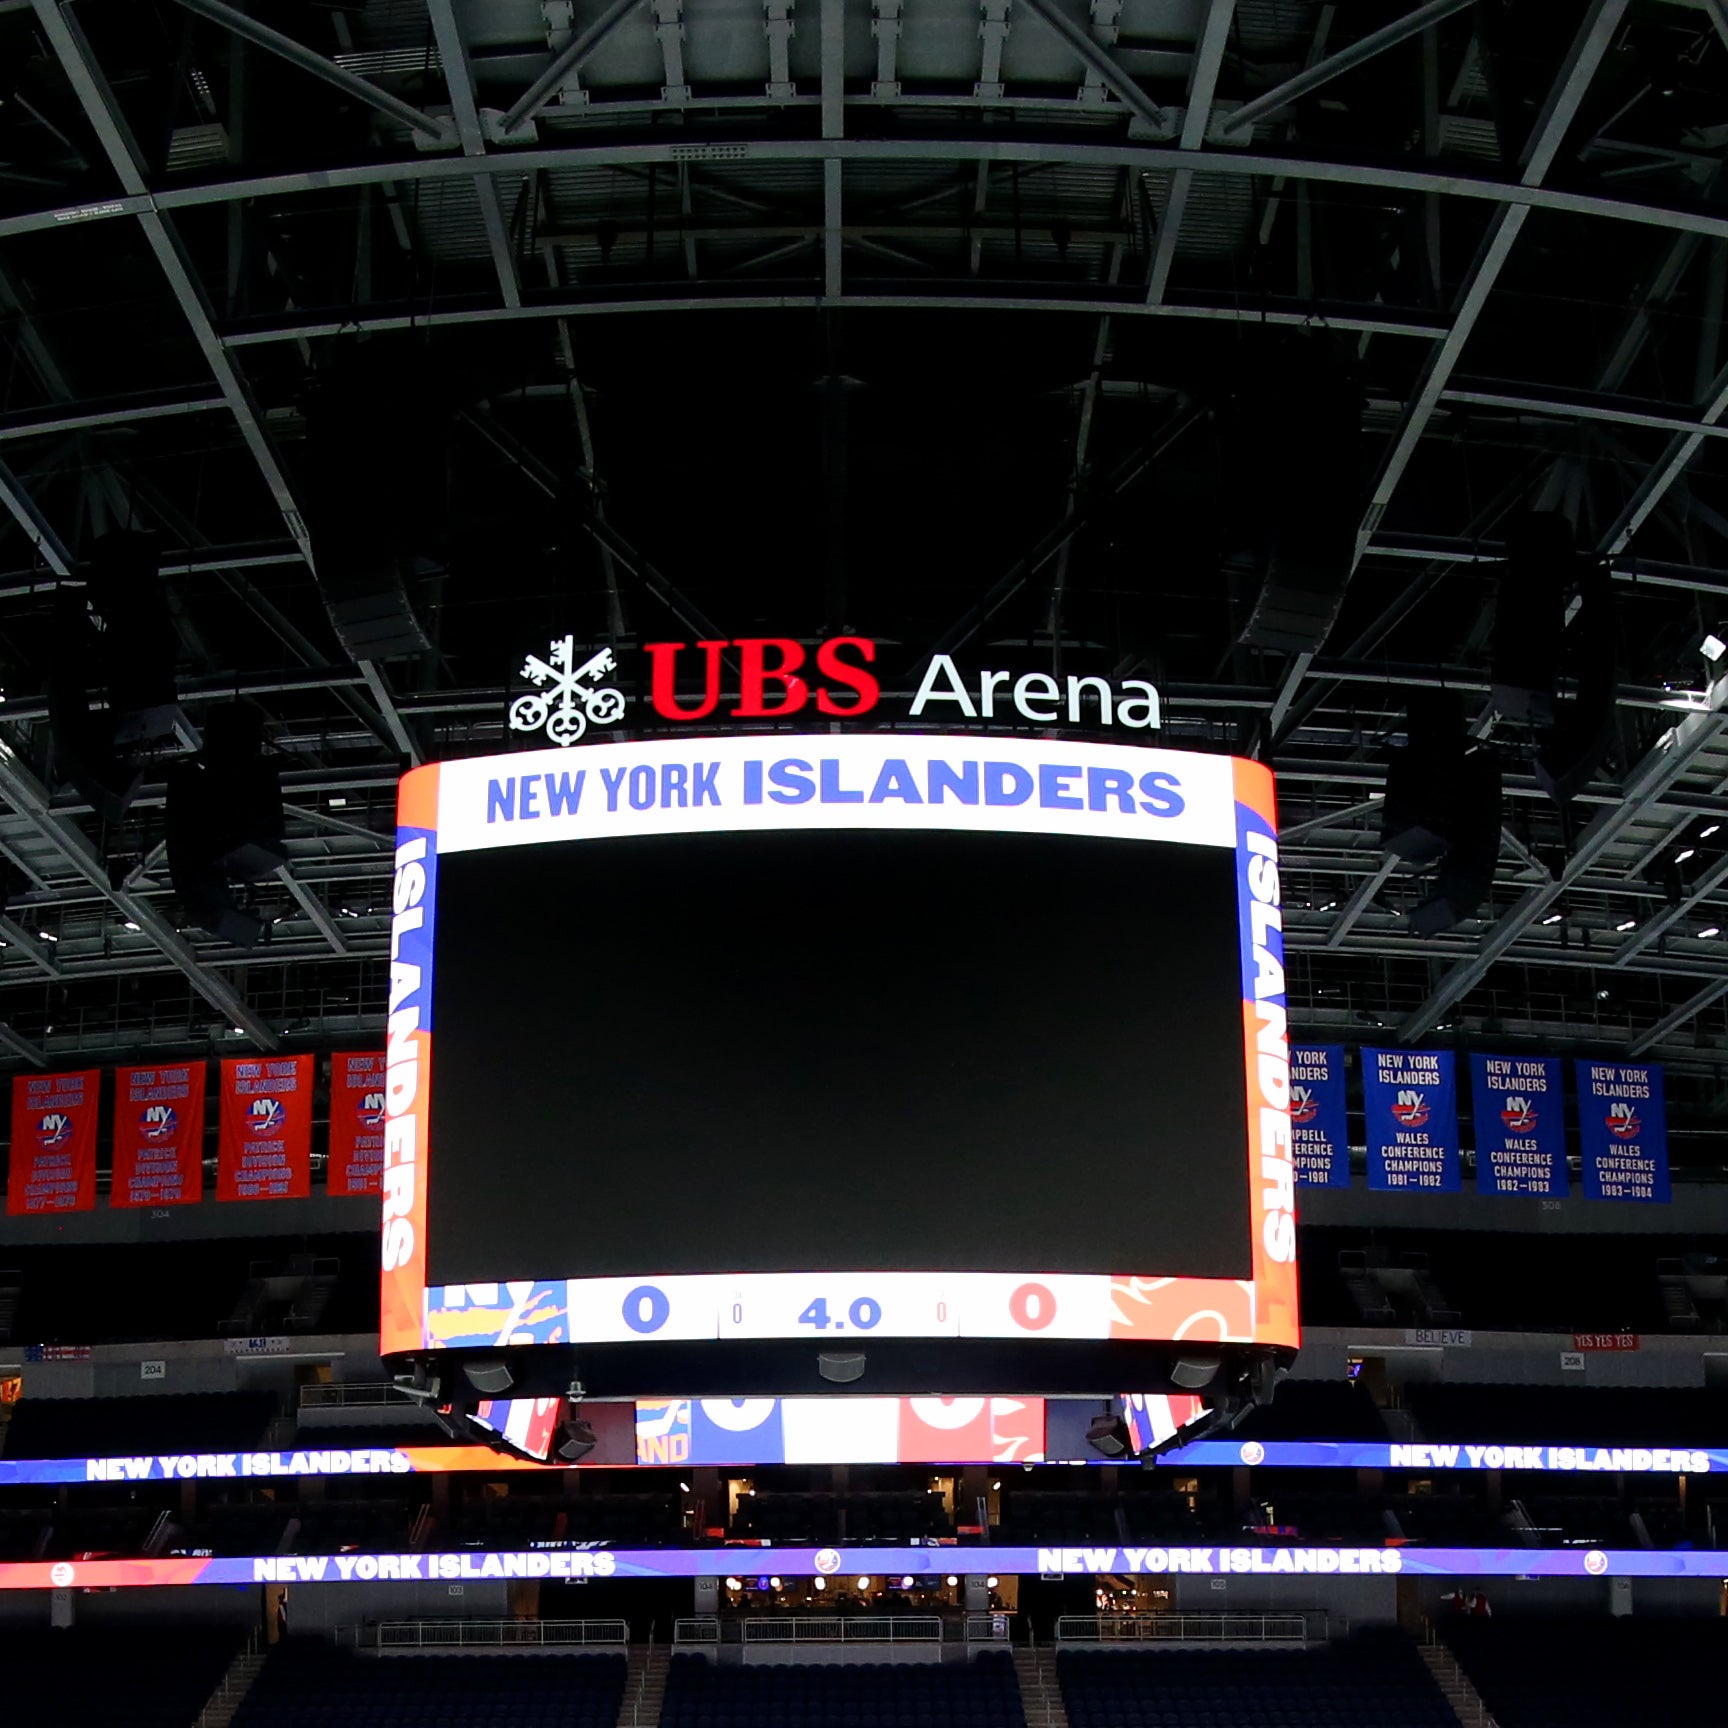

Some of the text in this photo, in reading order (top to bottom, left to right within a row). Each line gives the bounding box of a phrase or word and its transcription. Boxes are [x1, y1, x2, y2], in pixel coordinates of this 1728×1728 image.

[643, 635, 1163, 730] UBS Arena
[486, 757, 1186, 823] NEW YORK ISLANDERS
[1245, 831, 1298, 1265] ISLANDERS
[380, 837, 426, 1274] ISLANDERS
[1296, 1051, 1327, 1065] YORK
[1378, 1054, 1438, 1070] NEW YORK
[1486, 1060, 1545, 1076] NEW YORK
[1378, 1071, 1440, 1085] ISLANDERS
[1487, 1076, 1547, 1092] ISLANDERS
[1396, 1133, 1429, 1144] WALES
[1504, 1138, 1537, 1150] WALES
[1381, 1146, 1445, 1159] CONFERENCE
[1609, 1144, 1641, 1156] WALES
[1490, 1152, 1553, 1165] CONFERENCE
[1596, 1157, 1656, 1171] CONFERENCE
[1385, 1160, 1443, 1172] CHAMPIONS
[1494, 1165, 1551, 1179] CHAMPIONS
[1599, 1171, 1654, 1185] CHAMPIONS
[621, 1285, 671, 1335] 0
[797, 1296, 883, 1331] 4.0
[1009, 1282, 1059, 1331] 0
[1415, 1331, 1465, 1344] BELIEVE
[1575, 1334, 1634, 1347] YES YES YES
[144, 1365, 162, 1375] 204
[1390, 1444, 1711, 1472] NEW YORK ISLANDERS
[254, 1550, 617, 1582] NEW YORK ISLANDERS
